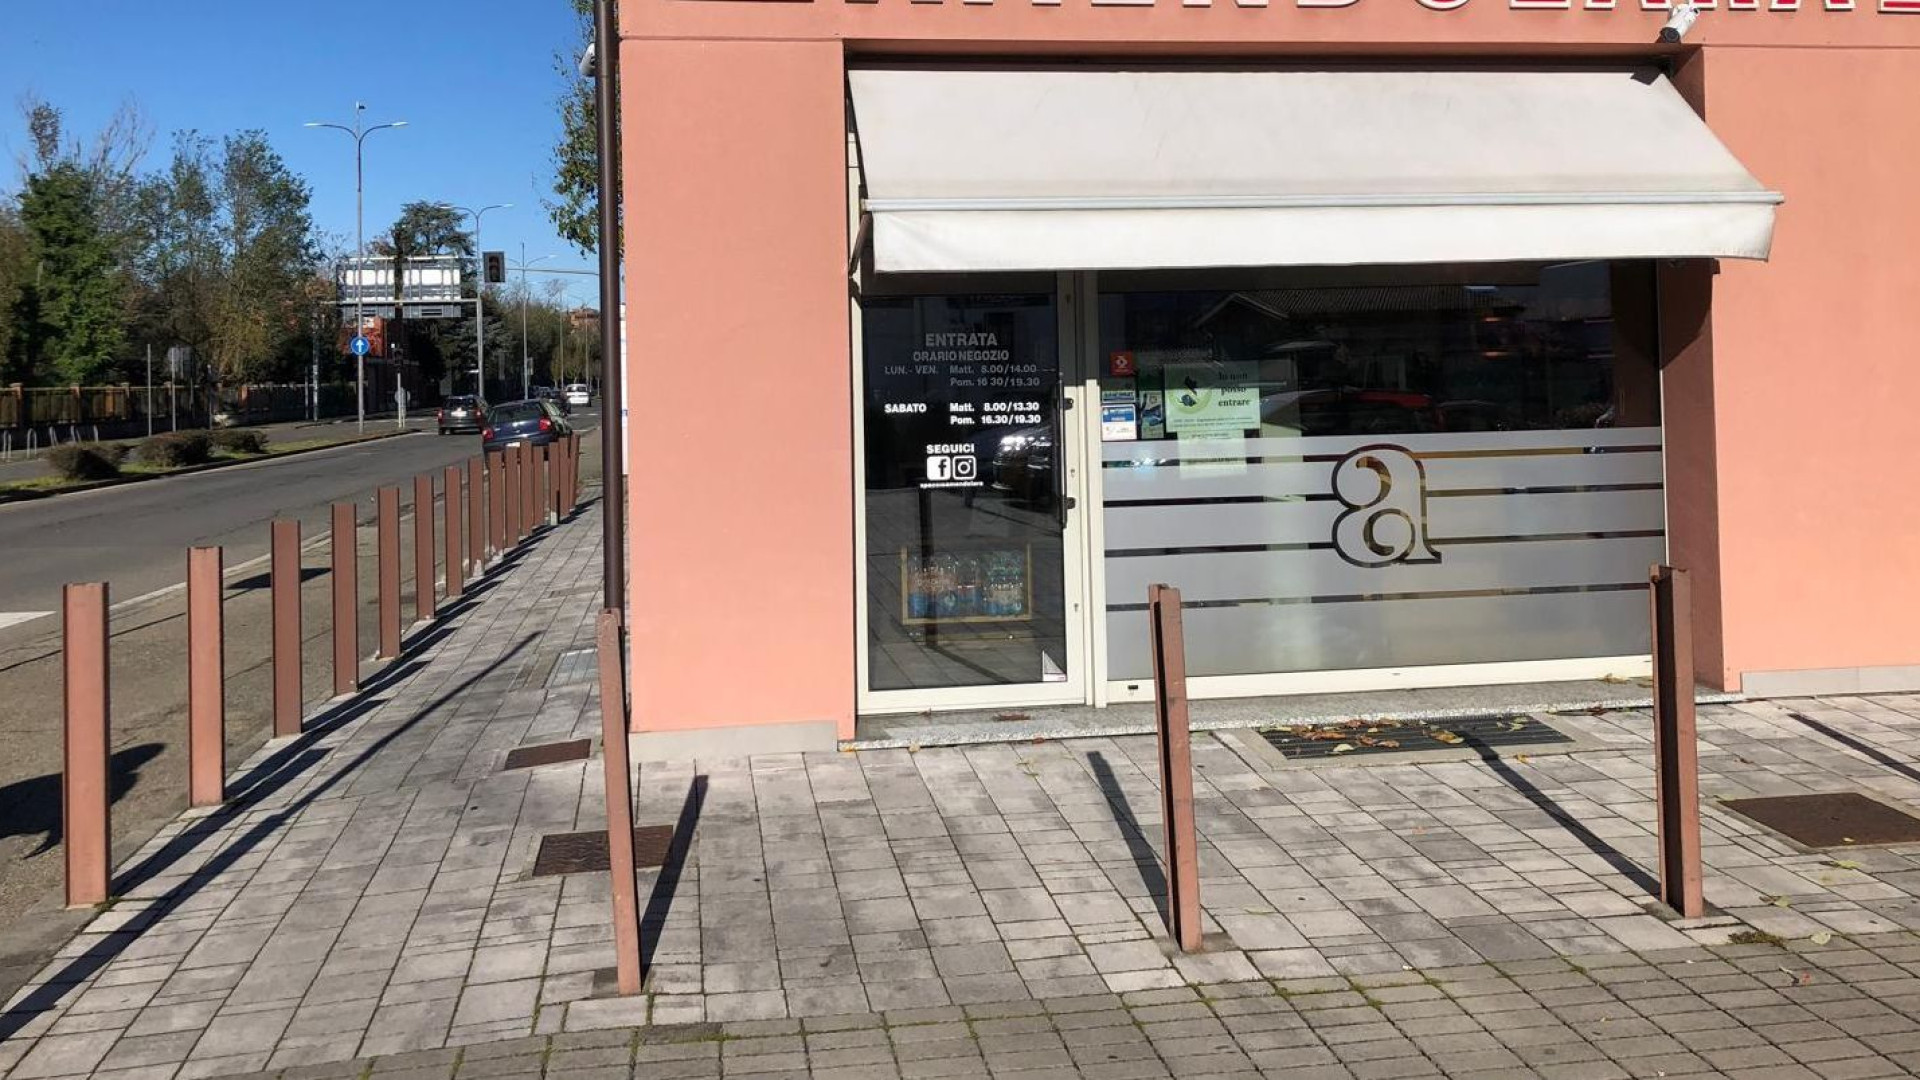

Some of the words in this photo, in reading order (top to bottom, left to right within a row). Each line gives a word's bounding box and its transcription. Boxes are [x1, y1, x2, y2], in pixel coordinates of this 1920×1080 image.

[925, 332, 998, 347] ENTRATA
[913, 351, 958, 362] ORARIO
[958, 350, 1010, 361] NEGOZIO
[949, 365, 975, 374] Matt.
[949, 377, 975, 387] Pom.
[884, 403, 927, 414] SABATO
[949, 402, 975, 412] Matt.
[983, 401, 1040, 413] 8.00/13.30
[1218, 397, 1250, 408] entrare
[949, 415, 975, 425] Pom.
[981, 414, 1042, 426] 16.30/19.30
[926, 443, 975, 454] SEGUICI
